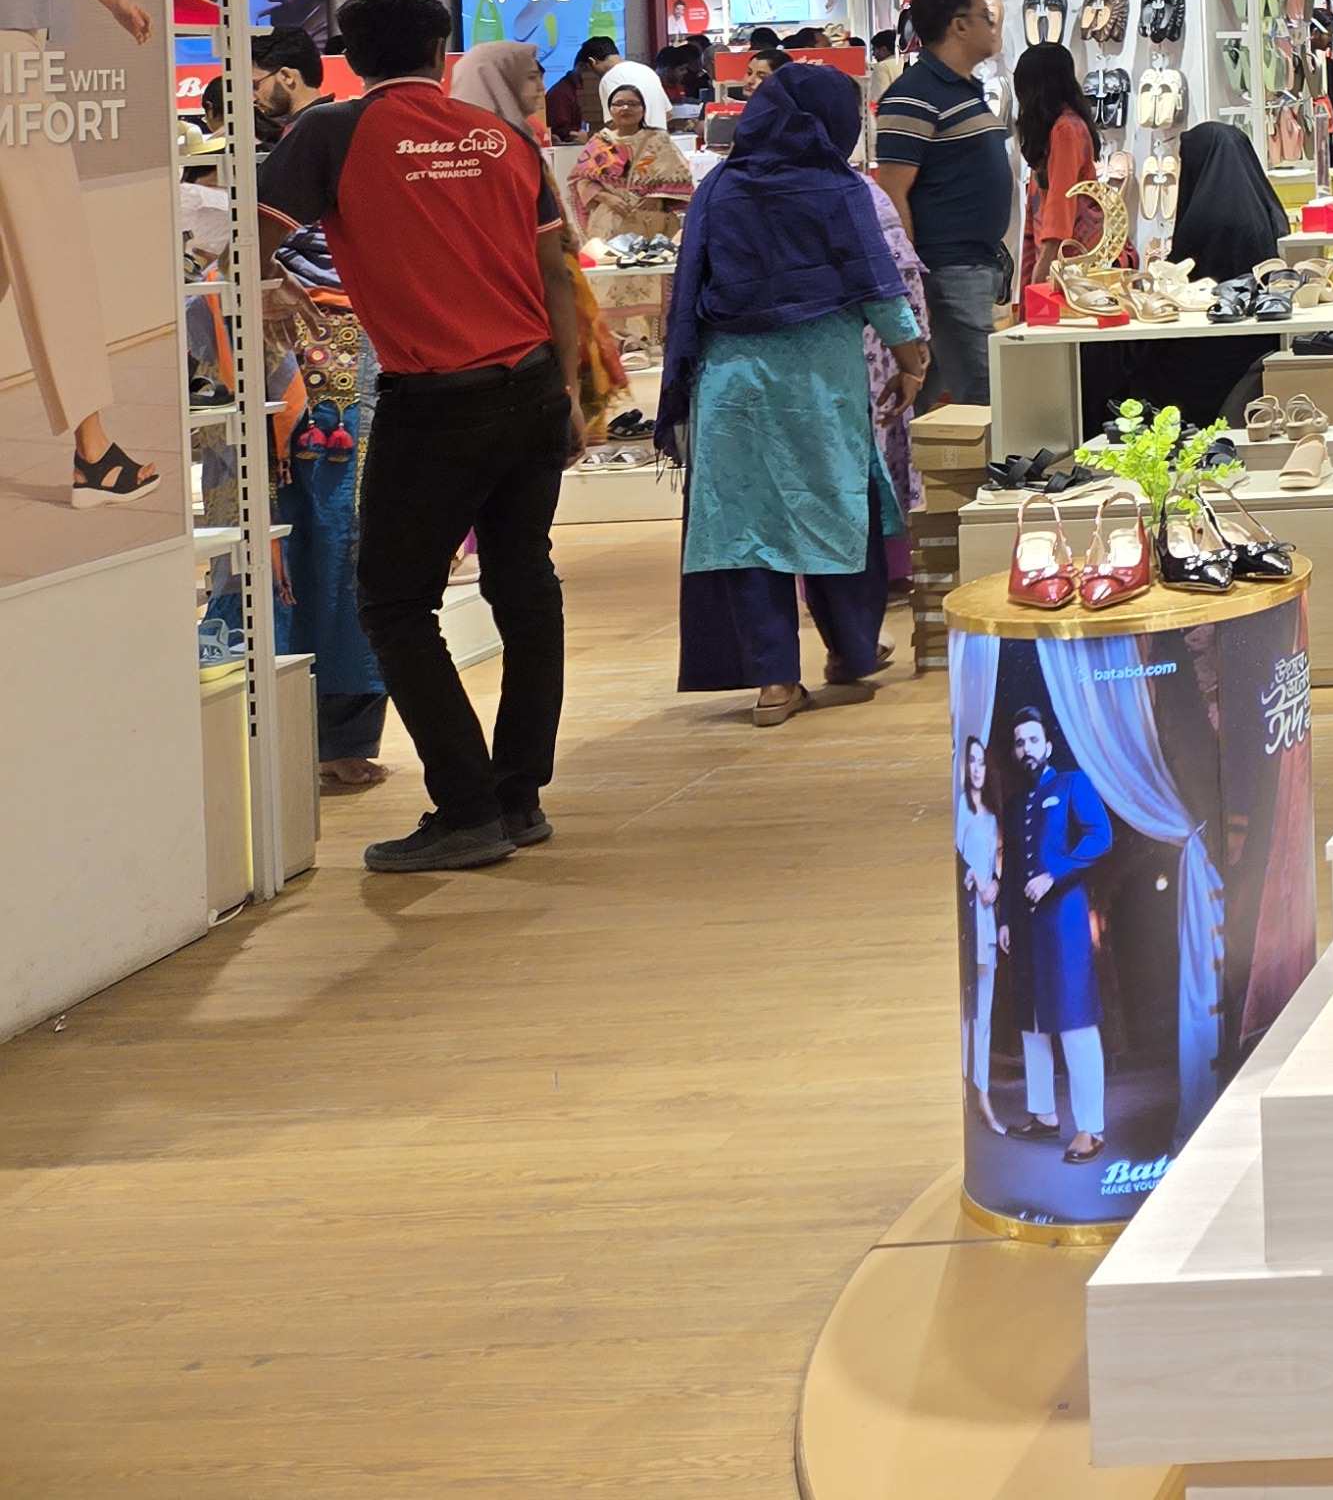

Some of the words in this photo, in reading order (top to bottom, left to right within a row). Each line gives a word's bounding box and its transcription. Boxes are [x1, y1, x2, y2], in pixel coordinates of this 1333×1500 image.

[70, 69, 125, 91] WITH
[396, 140, 456, 153] Bata
[459, 138, 498, 152] Club
[431, 160, 454, 169] JOIN
[456, 159, 480, 167] AND
[405, 171, 425, 181] GET
[1094, 662, 1177, 681] batabd.com
[1101, 1183, 1131, 1195] MAKE
